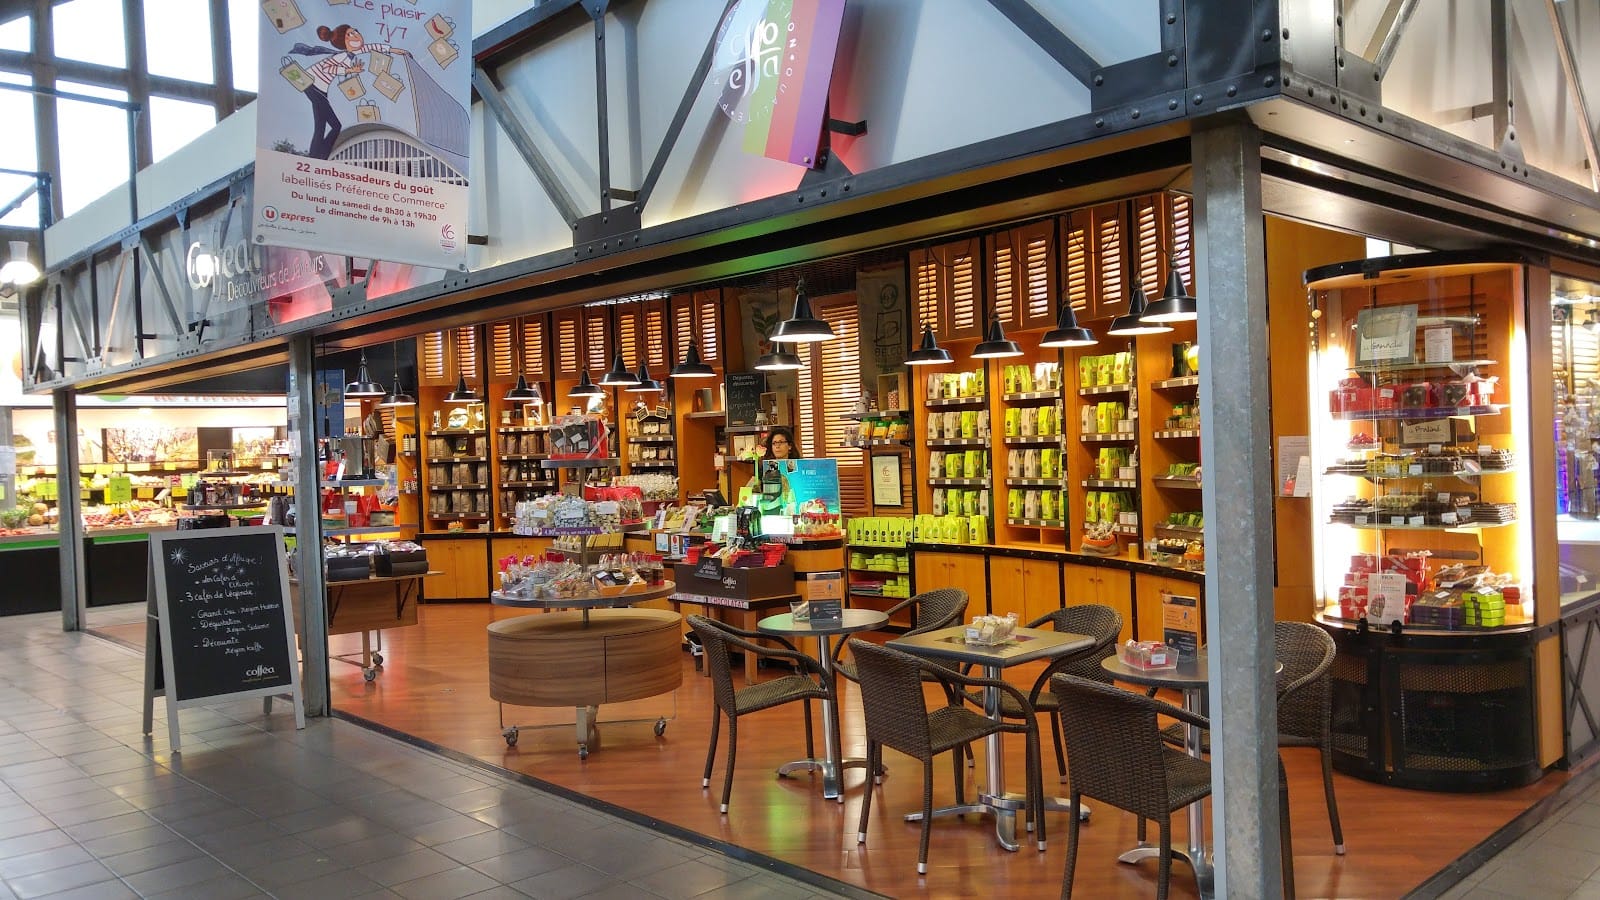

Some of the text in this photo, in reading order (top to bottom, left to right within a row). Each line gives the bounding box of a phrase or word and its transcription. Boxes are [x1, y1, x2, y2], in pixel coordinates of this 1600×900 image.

[381, 3, 426, 20] plaisir
[281, 172, 332, 191] labellisés
[335, 182, 390, 201] Préférence
[296, 162, 434, 195] 22 ambassadeurs du goût
[280, 212, 316, 224] express
[291, 190, 304, 200] Du
[306, 193, 327, 204] lundi
[342, 201, 371, 211] samedi
[372, 204, 383, 213] de
[384, 206, 405, 217] 8h30
[406, 210, 412, 218] à
[414, 211, 437, 222] 19h30
[315, 205, 415, 228] Le dimanche de 9h à 13h
